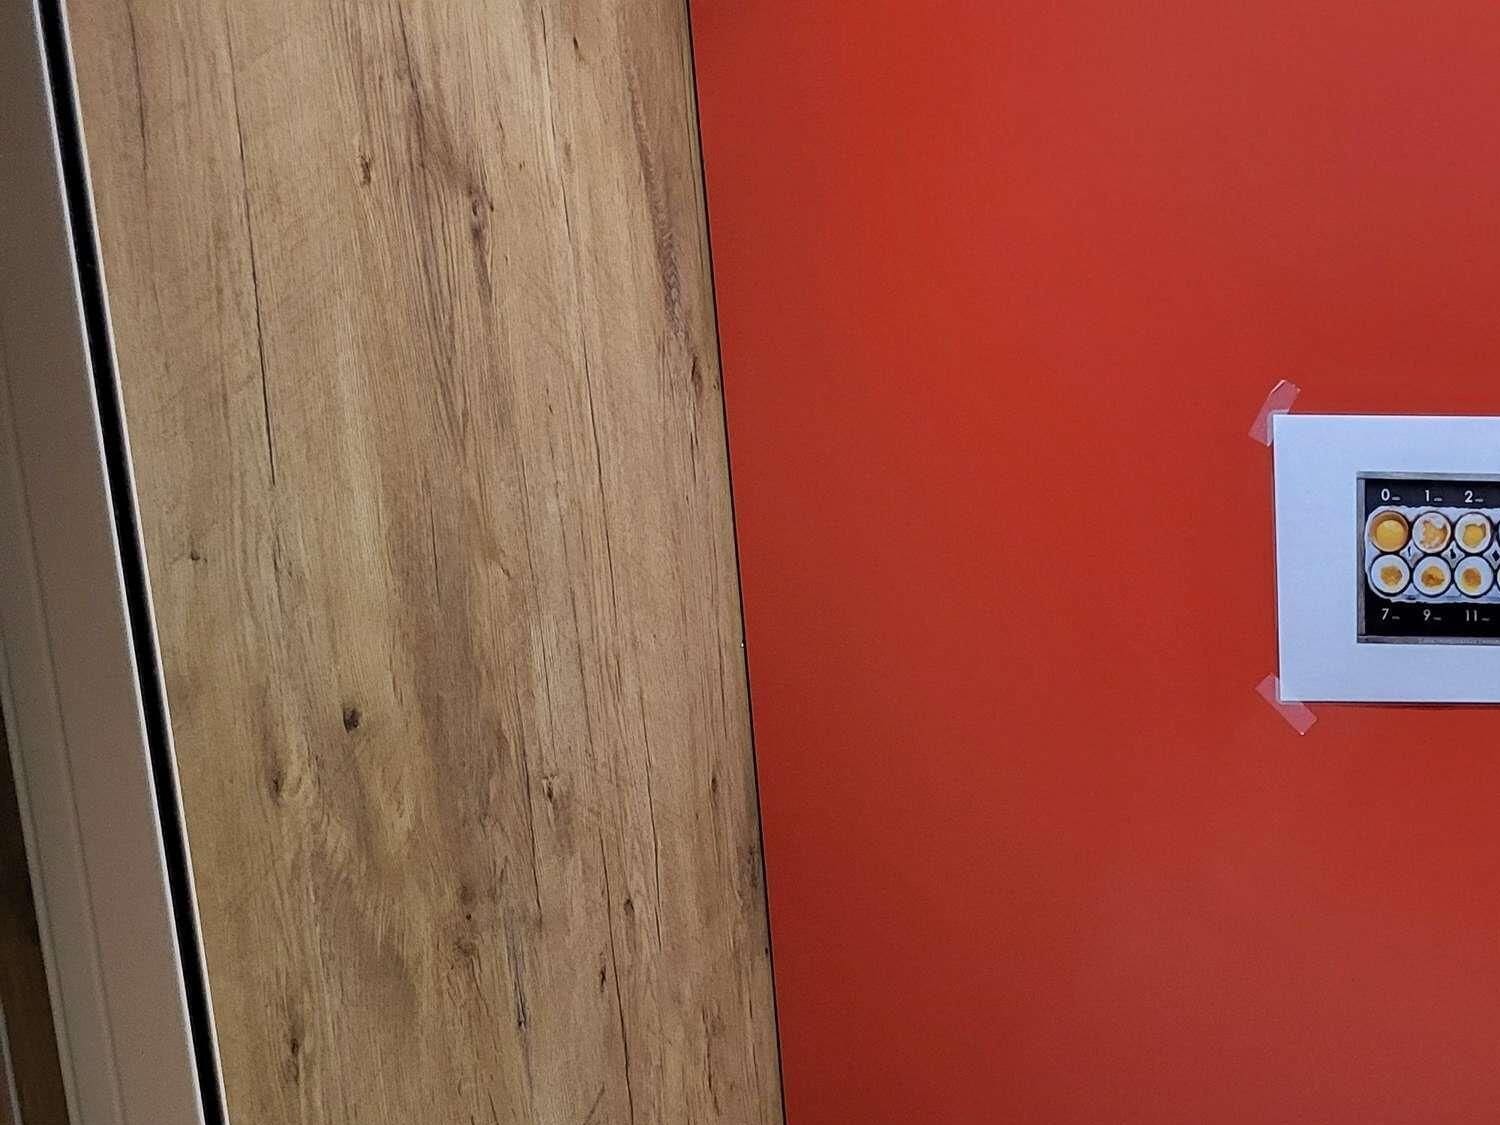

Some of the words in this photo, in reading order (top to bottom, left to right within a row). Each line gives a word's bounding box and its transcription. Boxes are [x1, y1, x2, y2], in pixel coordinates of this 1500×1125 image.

[1380, 488, 1391, 502] 0
[1424, 489, 1431, 502] 1
[1464, 490, 1473, 503] 2
[1381, 607, 1390, 621] 7
[1423, 608, 1431, 621] 9
[1465, 609, 1478, 622] 11
